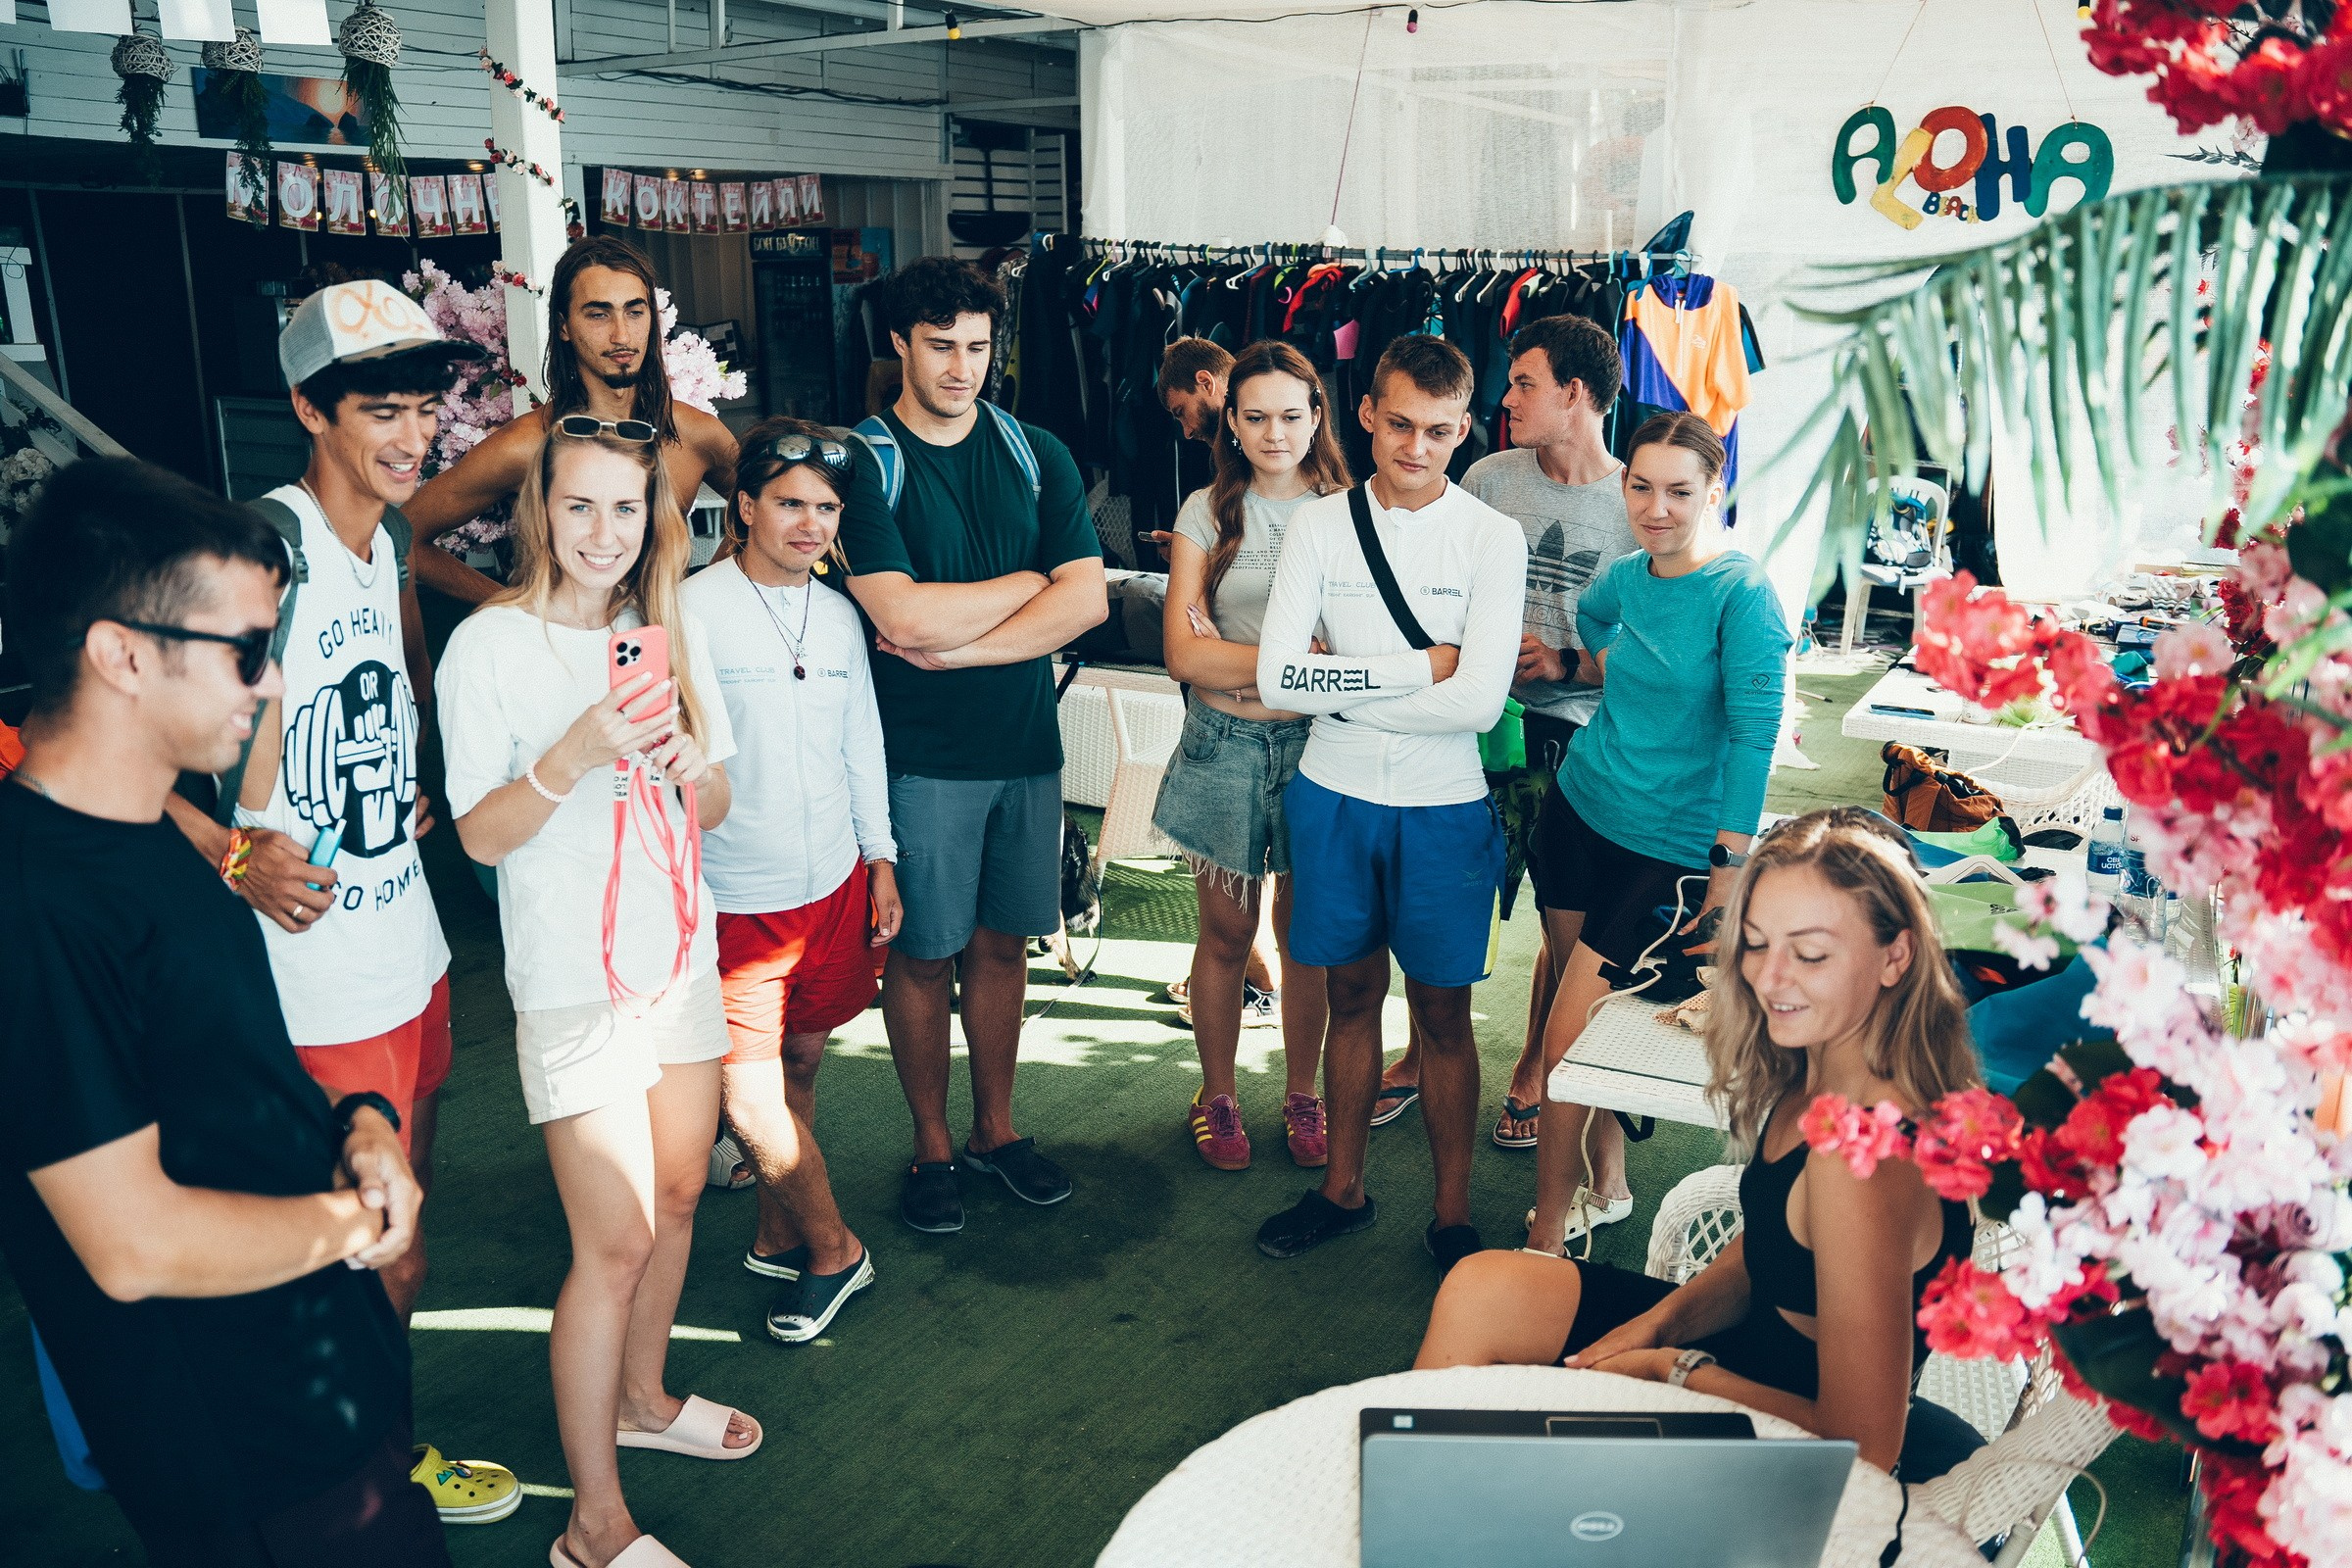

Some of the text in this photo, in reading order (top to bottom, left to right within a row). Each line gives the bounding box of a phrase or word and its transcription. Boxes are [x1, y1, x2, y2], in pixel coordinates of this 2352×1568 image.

[1832, 106, 2114, 230] ALOHA
[604, 177, 821, 225] КОКТЕЙЛИ
[1922, 192, 1980, 224] BEACH
[1327, 580, 1352, 589] TRAVEL
[1431, 587, 1464, 598] BARREL
[318, 618, 344, 660] GO
[359, 670, 379, 702] OR
[719, 667, 752, 676] TRAVEL
[1280, 663, 1382, 693] BARREL
[374, 858, 420, 912] HOME
